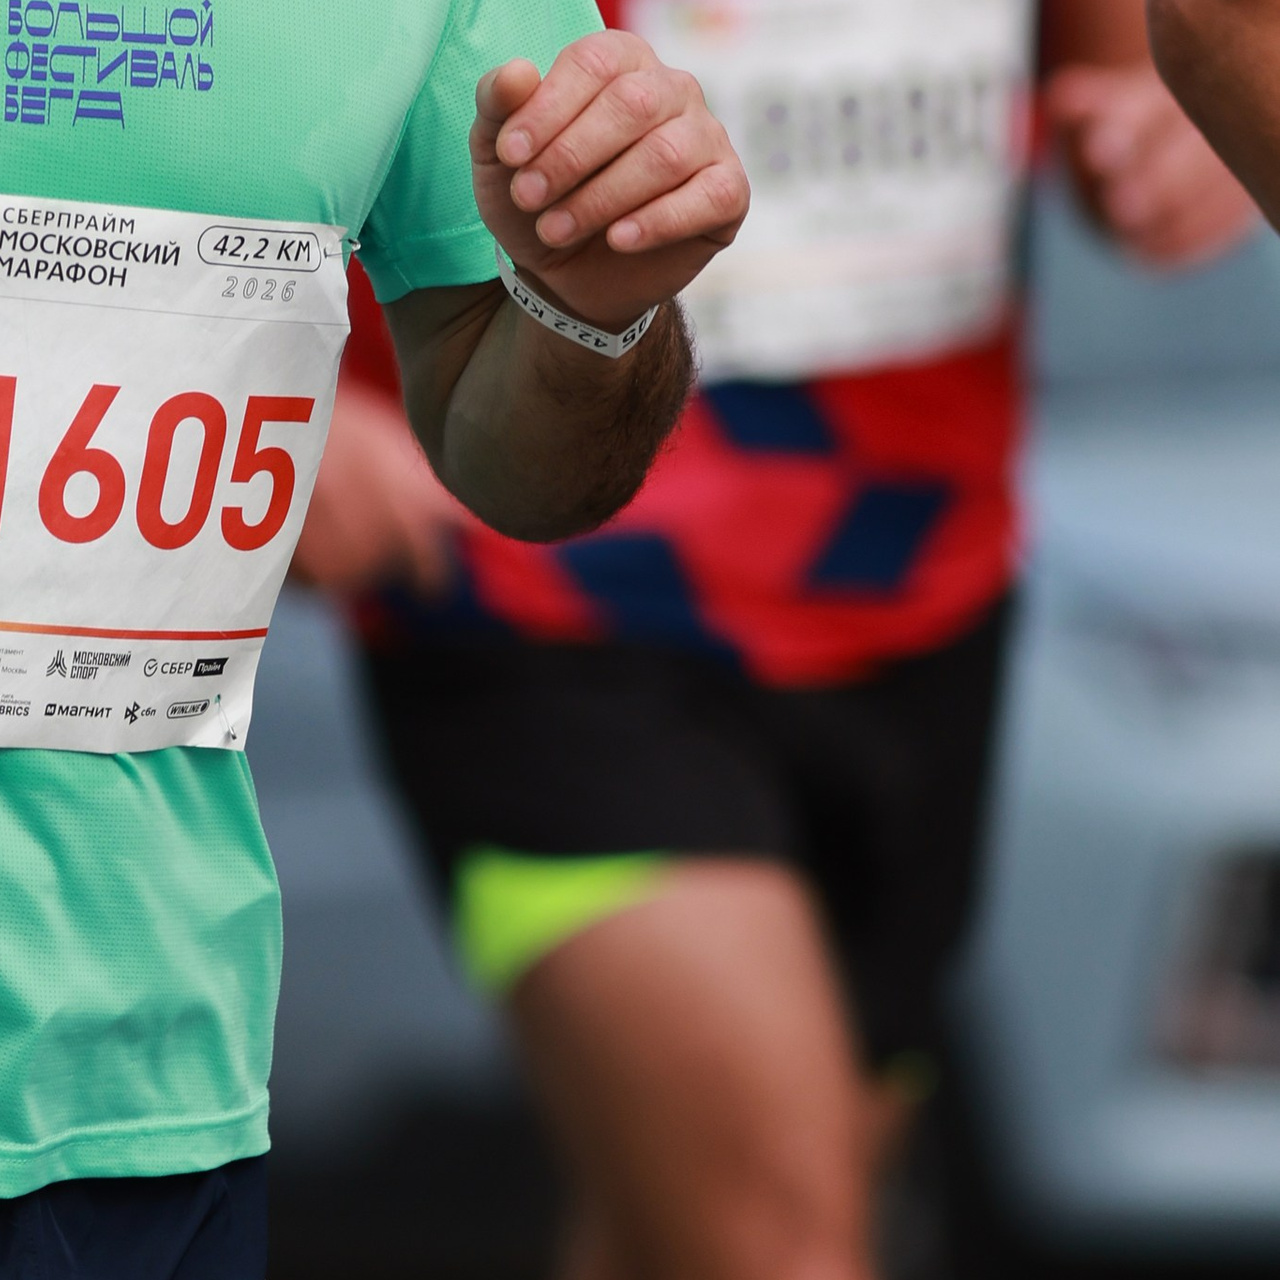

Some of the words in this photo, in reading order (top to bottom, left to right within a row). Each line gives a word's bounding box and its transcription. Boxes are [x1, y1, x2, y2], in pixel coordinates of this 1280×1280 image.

[4, 38, 214, 91] ФЕСТИВАЛЬ
[4, 84, 125, 130] БЕГА
[3, 206, 136, 235] СБЕРПРАЙМ
[213, 234, 270, 263] 42,2
[222, 276, 297, 302] 2026
[72, 650, 132, 668] МОСКОВСКИЙ
[160, 661, 193, 675] СБЕР
[70, 665, 99, 680] СПОРТ
[170, 704, 201, 716] WINLINE
